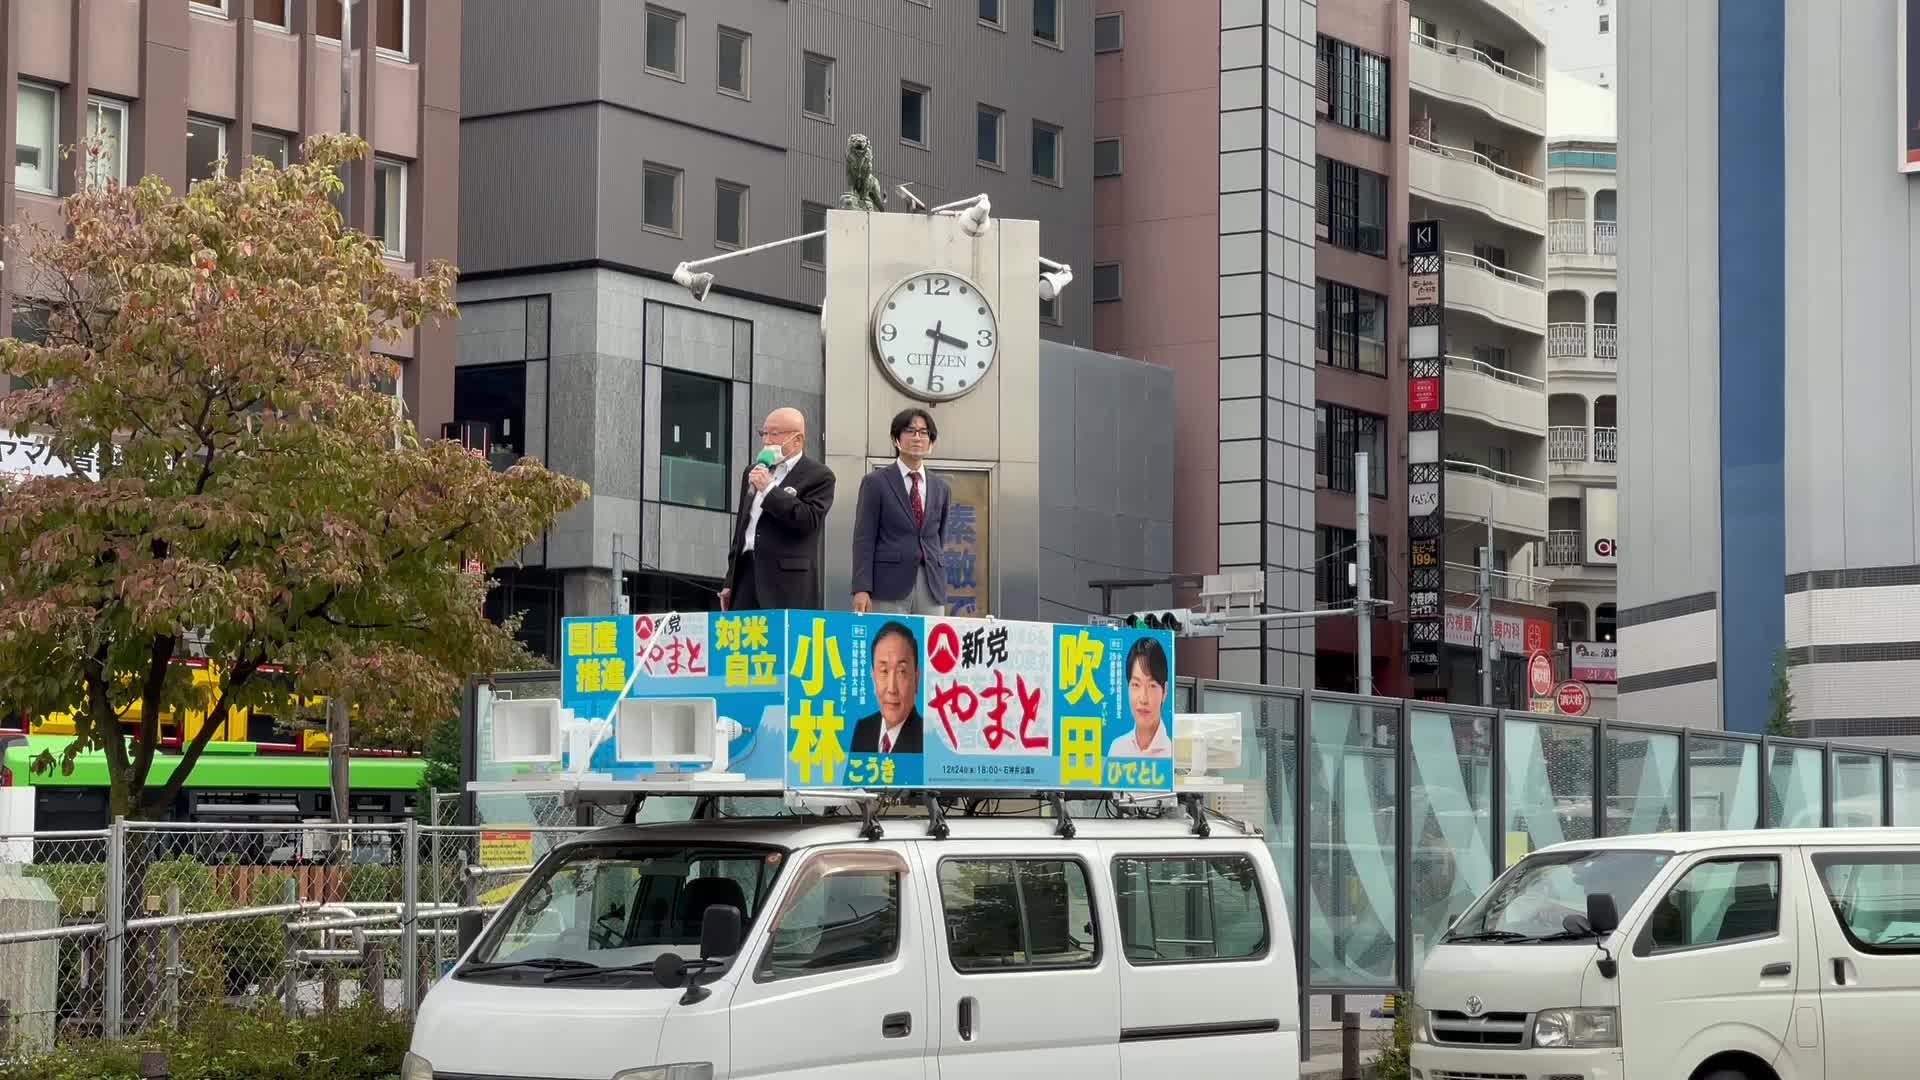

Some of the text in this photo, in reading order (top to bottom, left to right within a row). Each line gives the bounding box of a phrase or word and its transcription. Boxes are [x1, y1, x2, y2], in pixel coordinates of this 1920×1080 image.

[924, 278, 951, 296] 12
[881, 323, 898, 342] 9
[976, 329, 993, 347] 3
[906, 353, 967, 367] CITZEN
[928, 375, 944, 393] 6
[568, 621, 618, 656] 国産
[715, 615, 768, 651] 対米
[961, 626, 1009, 669] 新党
[636, 636, 706, 675] やまと
[726, 651, 778, 687] 自立
[576, 658, 626, 693] 推進
[789, 618, 847, 784] 小林
[927, 669, 1049, 752] やまと
[1059, 630, 1105, 785] 吹田
[1559, 693, 1584, 706] 消火栓
[848, 756, 896, 784] こうき
[1108, 761, 1165, 785] ひでとし
